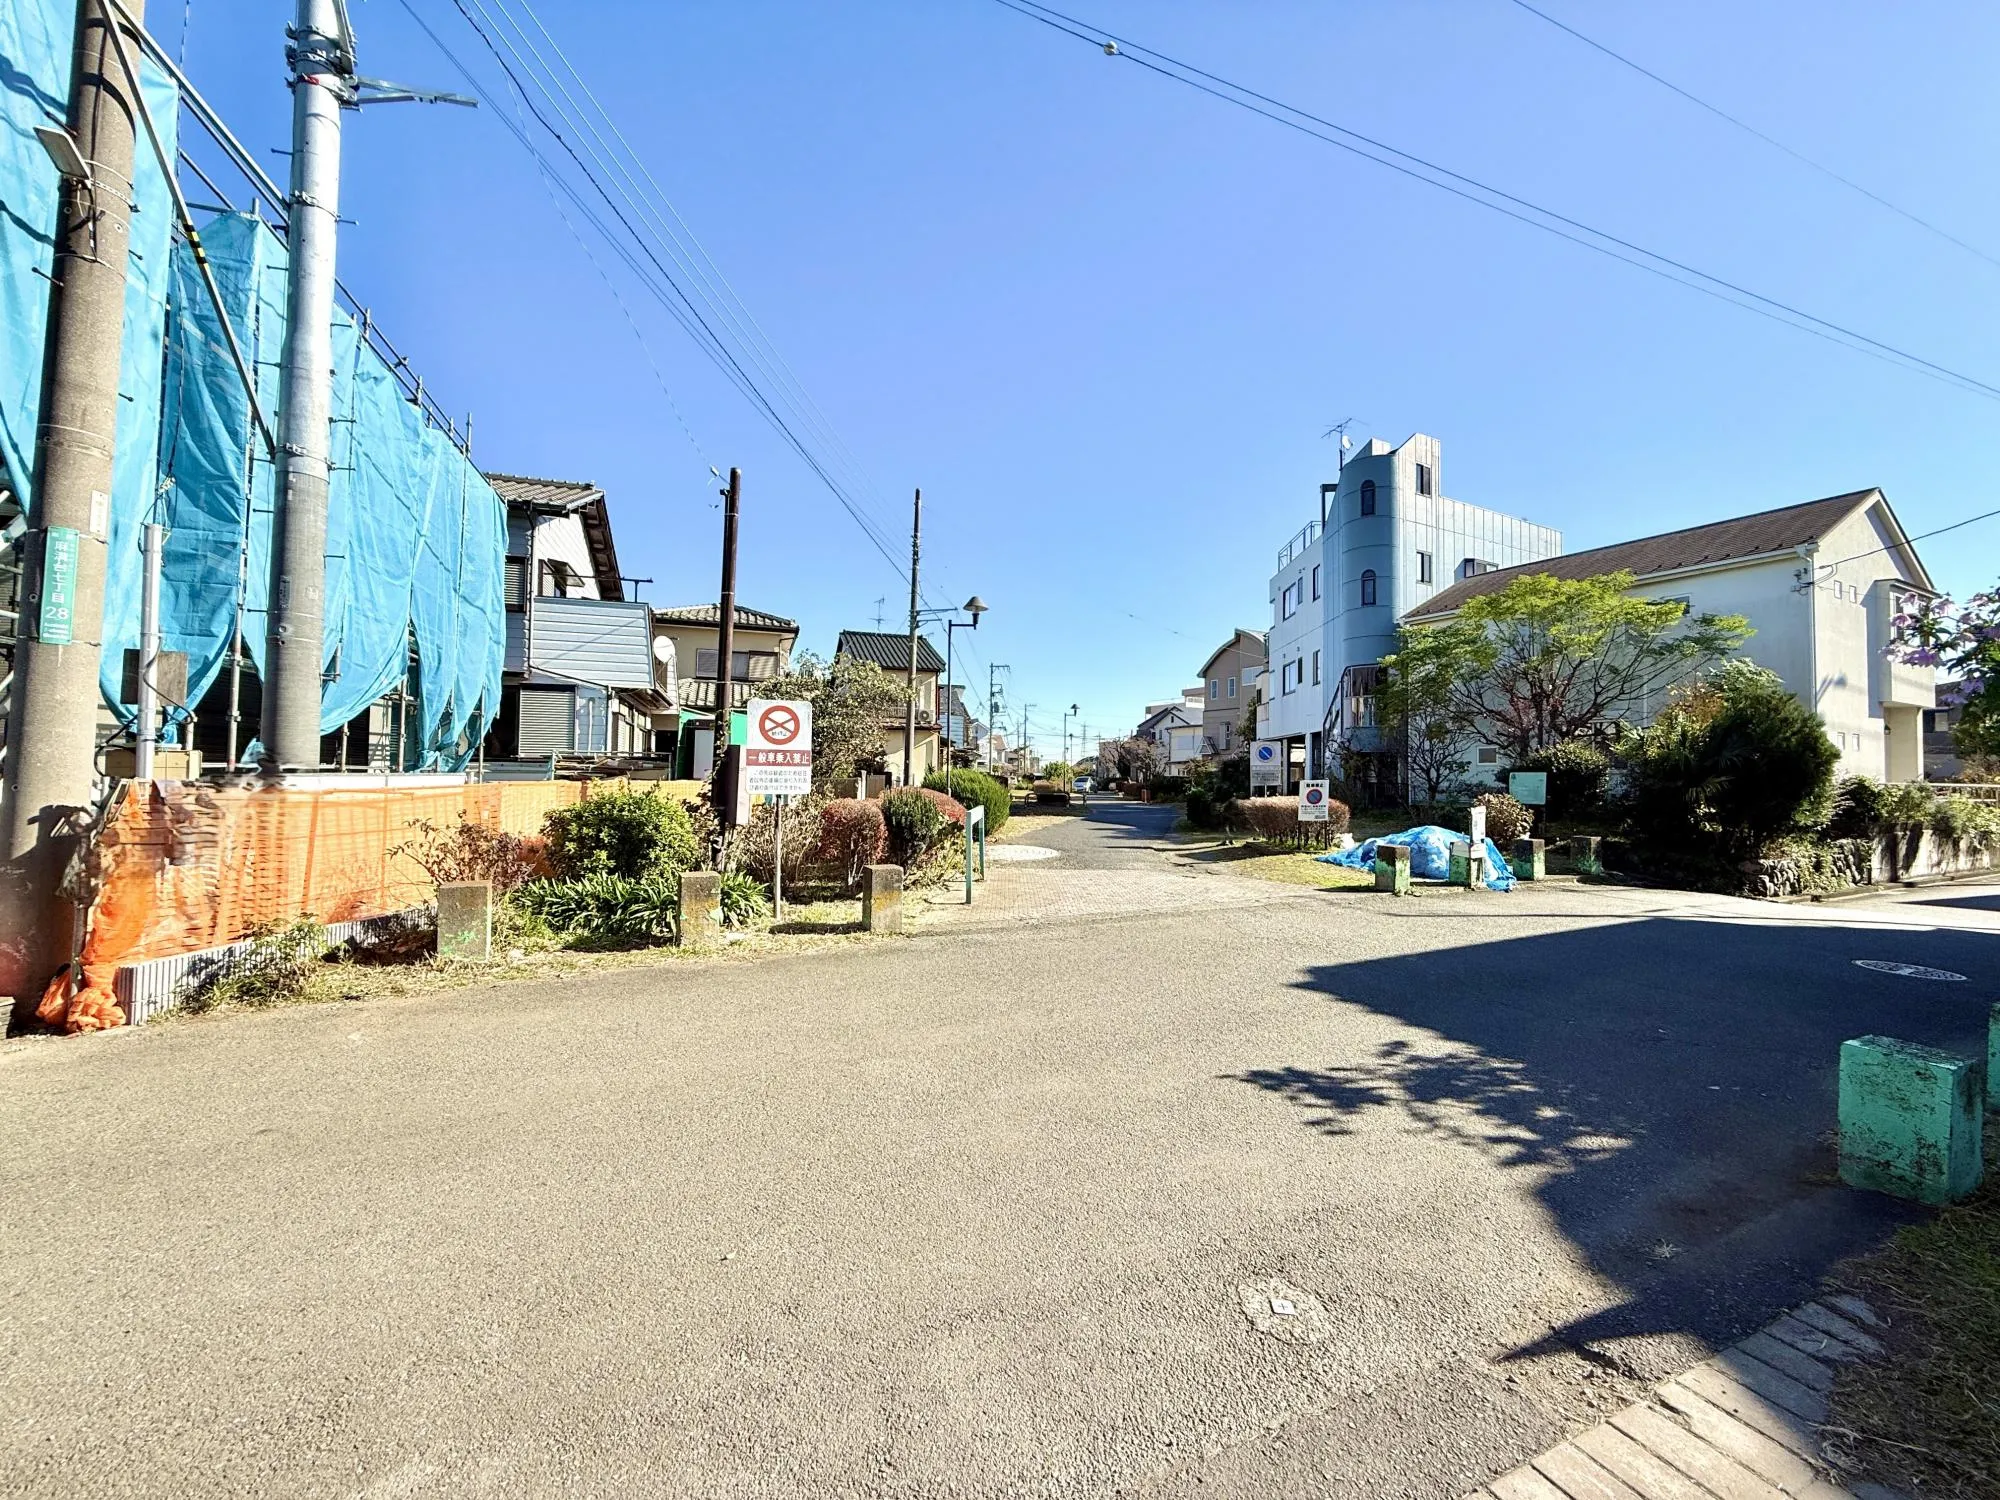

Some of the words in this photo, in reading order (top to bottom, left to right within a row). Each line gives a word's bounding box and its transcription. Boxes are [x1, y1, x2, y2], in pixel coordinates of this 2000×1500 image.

[44, 606, 69, 620] 28
[748, 751, 810, 764] 一般車乗入禁止
